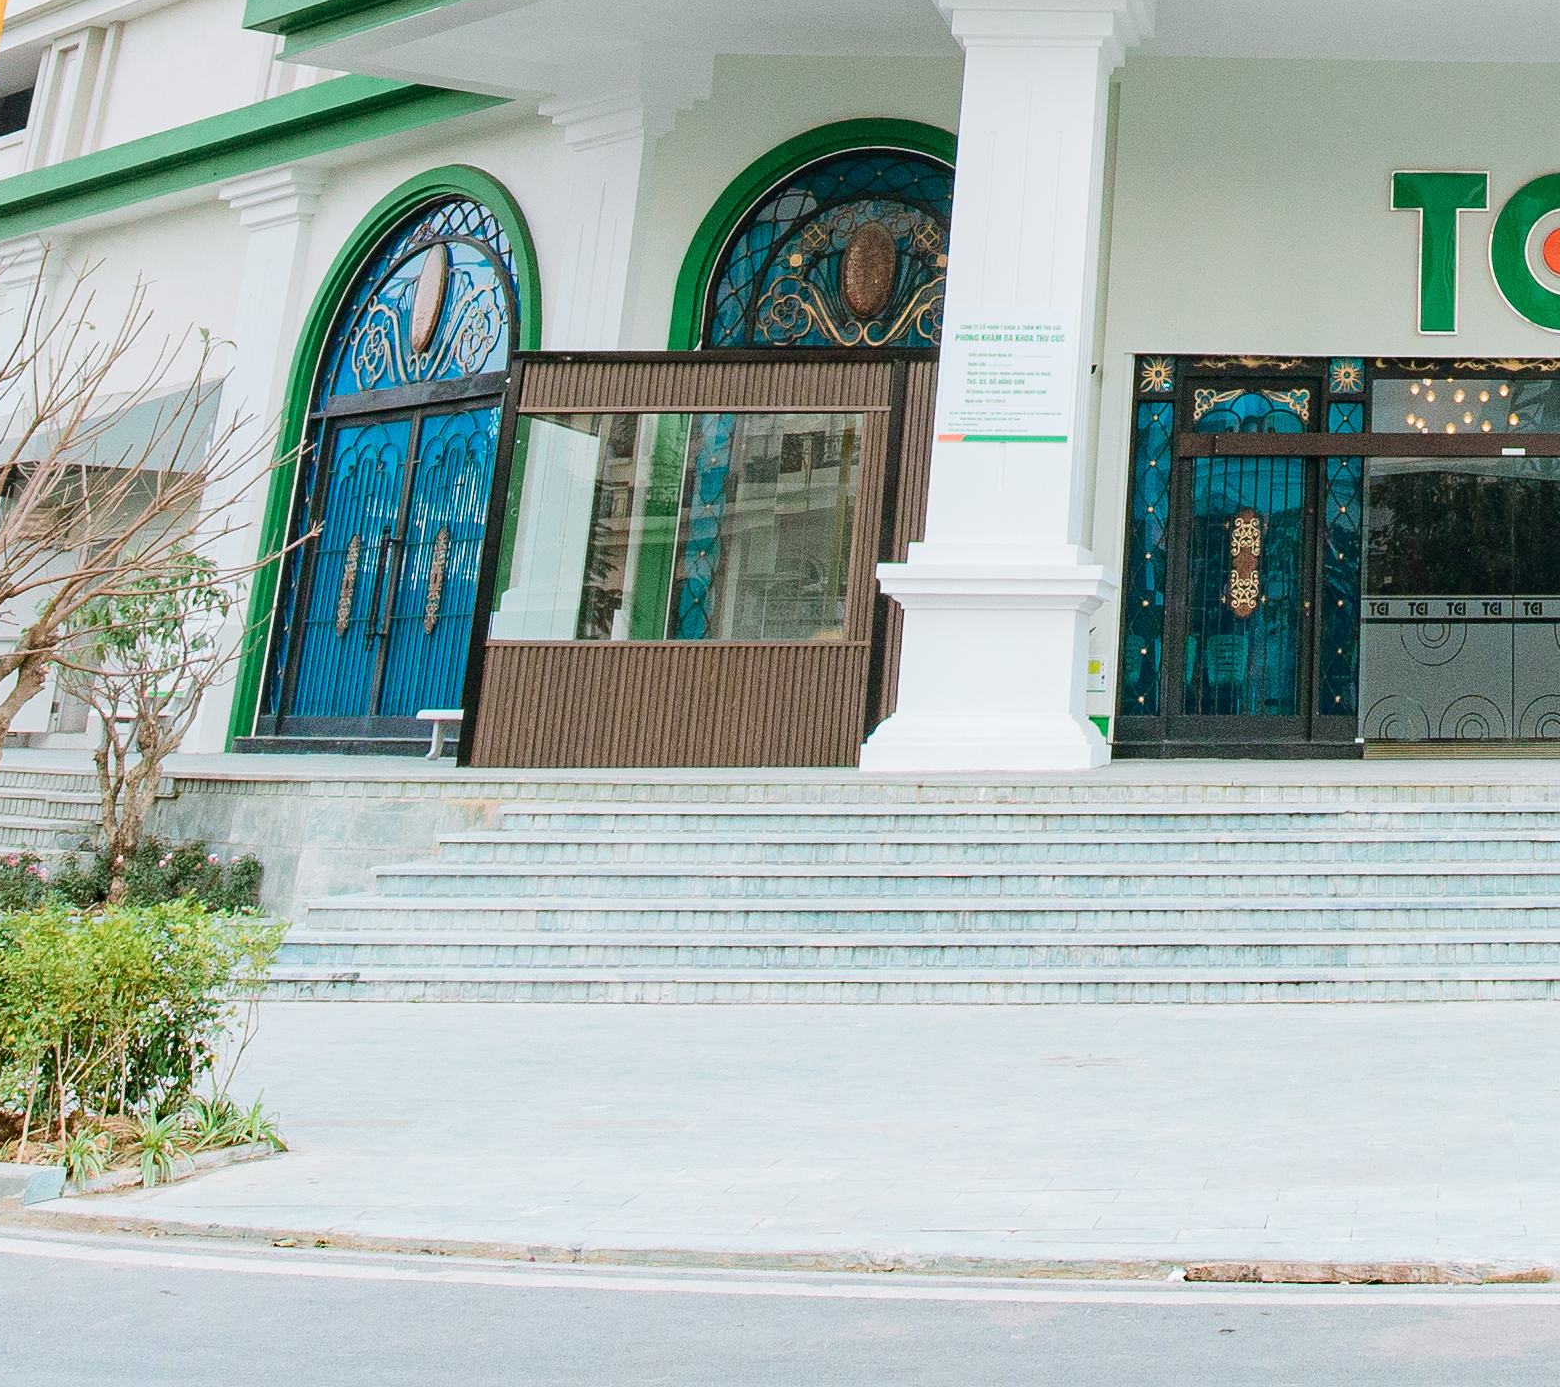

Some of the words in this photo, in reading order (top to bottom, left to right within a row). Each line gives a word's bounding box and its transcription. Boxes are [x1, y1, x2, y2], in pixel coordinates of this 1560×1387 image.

[955, 332, 980, 342] PHÒNG
[981, 332, 1002, 342] KHÁM
[1015, 334, 1034, 342] KHOA
[1036, 334, 1050, 342] THU
[1051, 332, 1066, 343] CÚC
[1369, 601, 1389, 616] TCI
[1408, 601, 1428, 616] TCI
[1446, 601, 1467, 616] TCI
[1482, 601, 1502, 616] TCI
[1522, 601, 1543, 616] TCI
